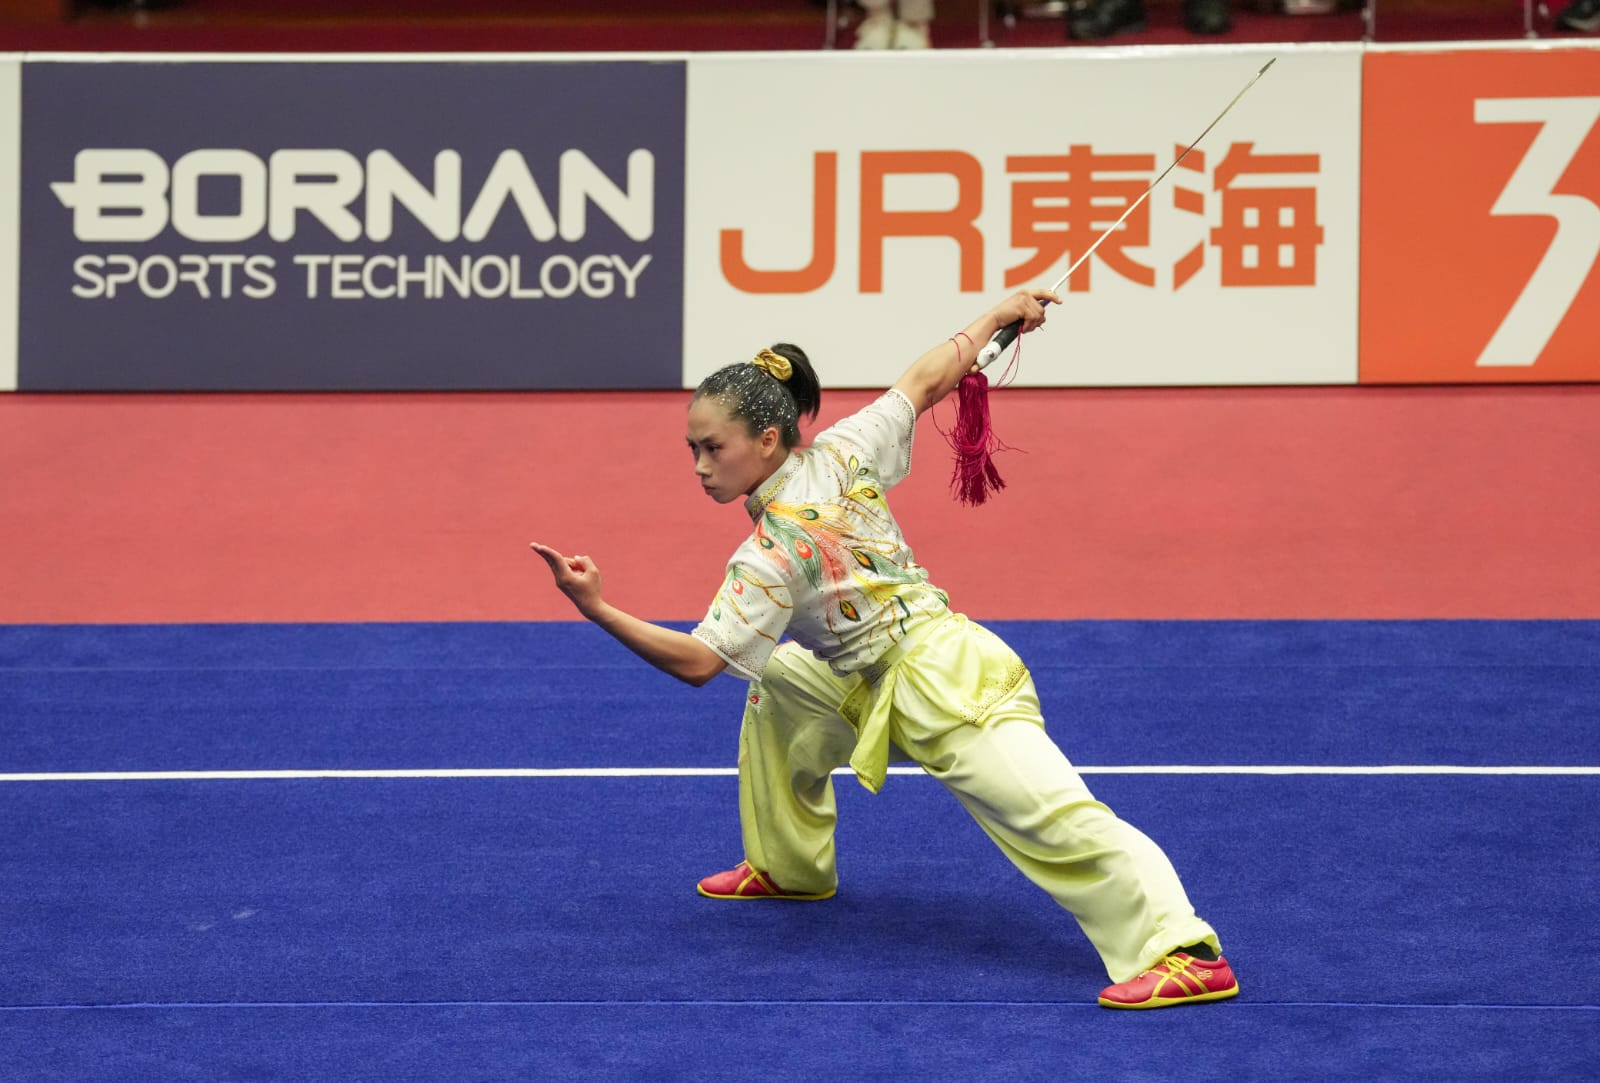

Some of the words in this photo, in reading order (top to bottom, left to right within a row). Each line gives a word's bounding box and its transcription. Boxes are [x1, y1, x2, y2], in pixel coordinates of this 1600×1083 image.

[50, 149, 654, 242] BORNAN
[719, 141, 1325, 294] JR東海
[72, 255, 276, 298] SPORTS
[293, 254, 652, 298] TECHNOLOGY
